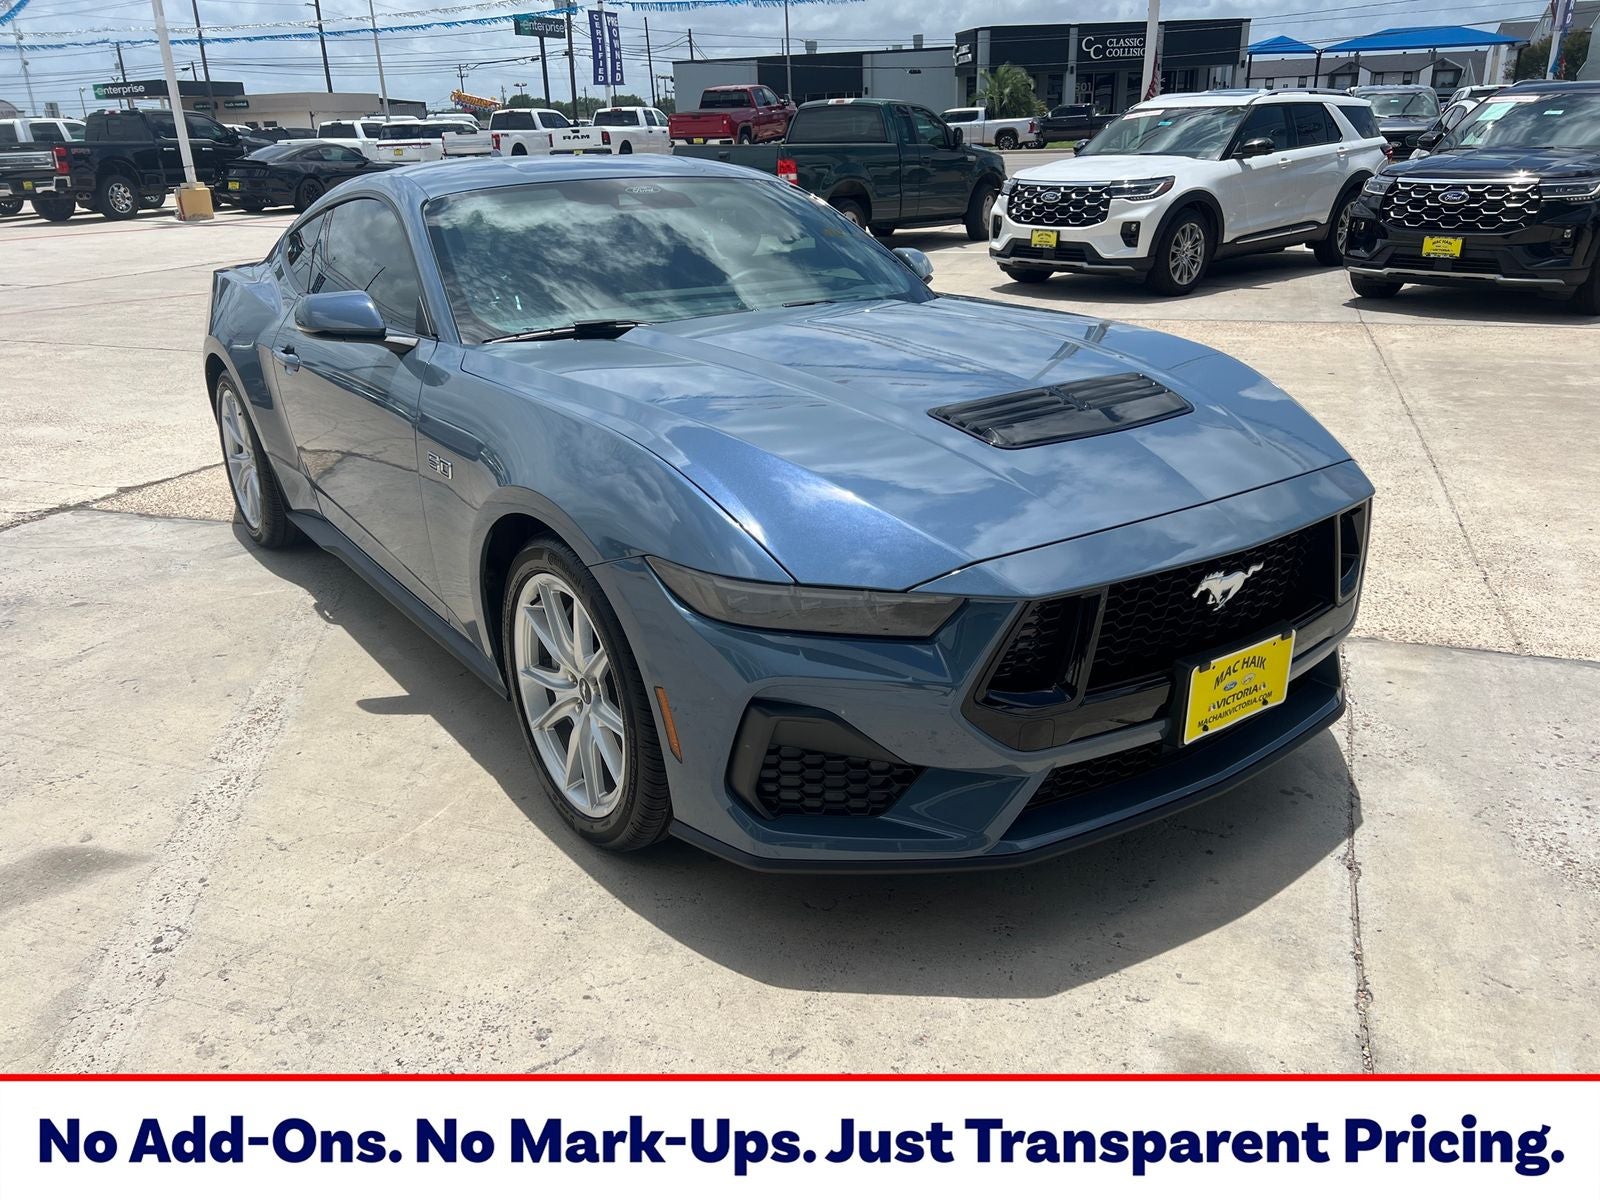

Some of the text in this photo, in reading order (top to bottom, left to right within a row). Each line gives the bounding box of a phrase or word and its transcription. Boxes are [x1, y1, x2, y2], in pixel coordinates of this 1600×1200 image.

[522, 19, 565, 35] enterprise
[606, 15, 618, 27] PRE
[593, 13, 604, 82] CERTIFIED
[1105, 48, 1147, 58] COLLISIO
[1106, 38, 1144, 48] CLASSIC
[612, 29, 622, 82] OWNED
[96, 83, 145, 97] enterprise
[1213, 659, 1240, 690] MAC
[1241, 655, 1267, 670] HAIK
[1216, 685, 1259, 709] VICTORIA
[1197, 691, 1273, 728] MACHAIKVICTORIA.COM
